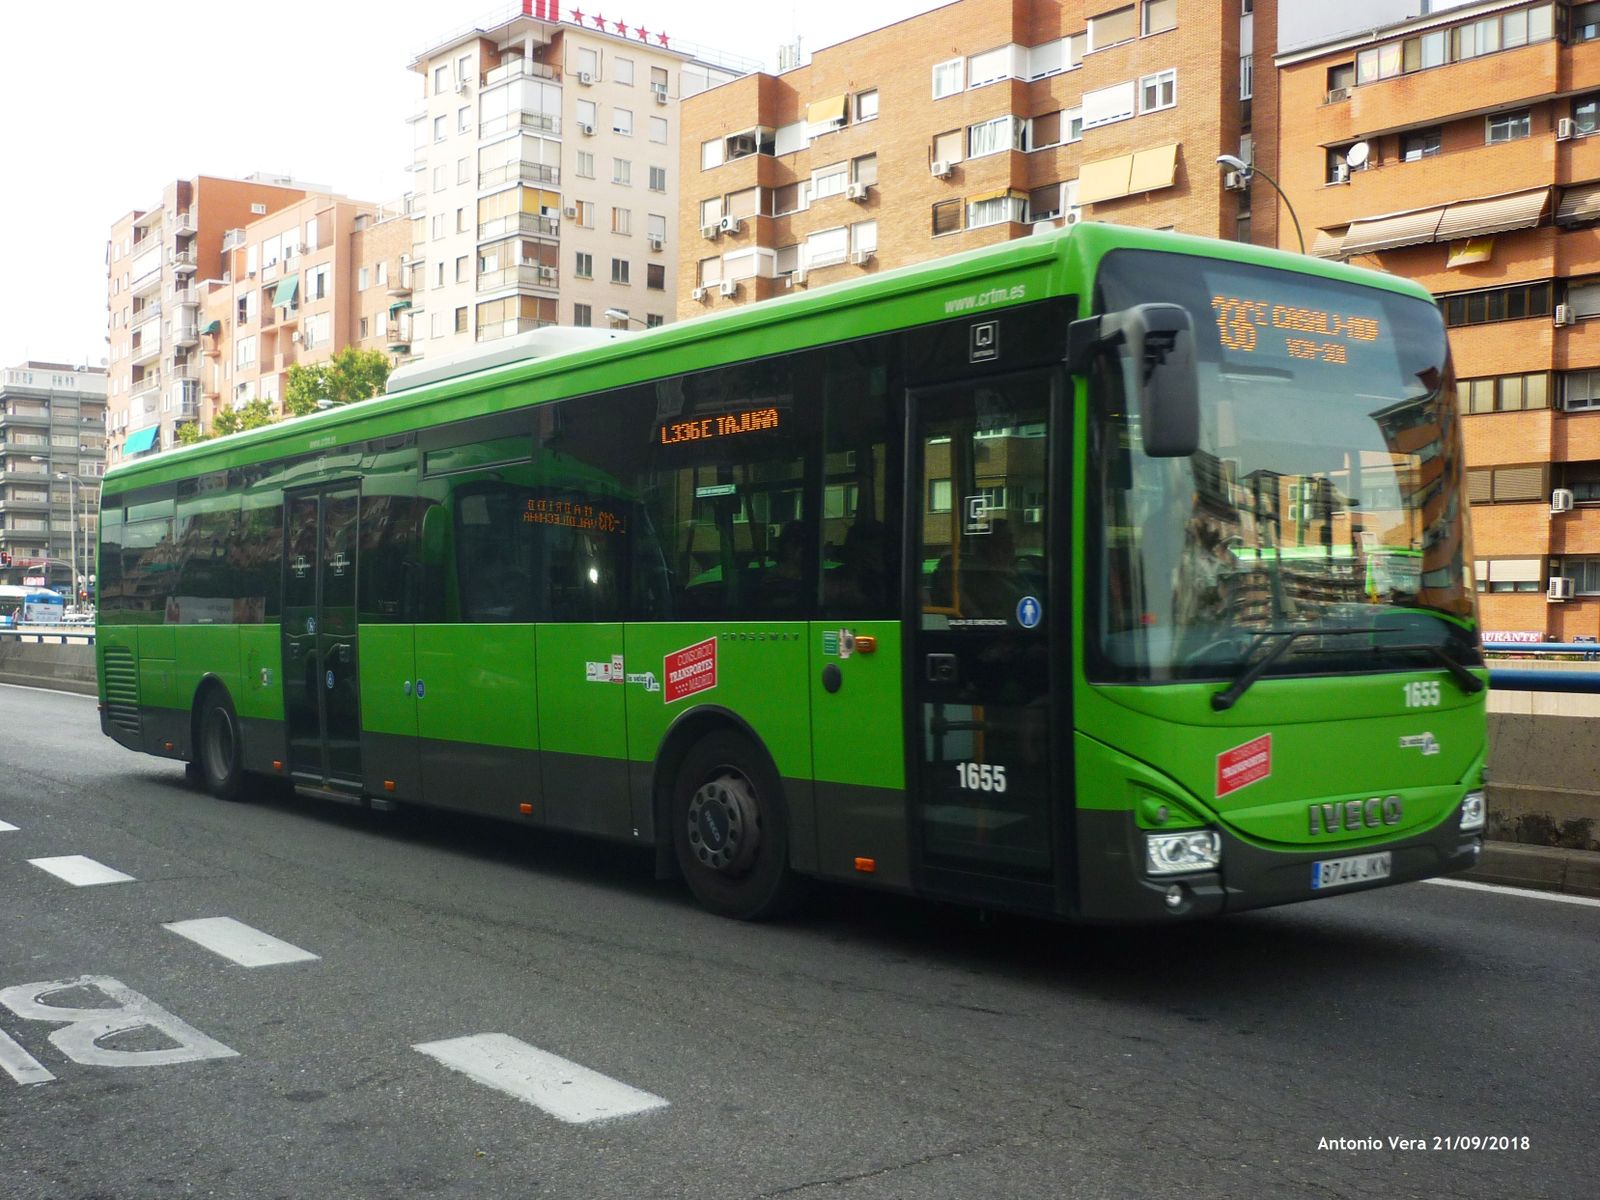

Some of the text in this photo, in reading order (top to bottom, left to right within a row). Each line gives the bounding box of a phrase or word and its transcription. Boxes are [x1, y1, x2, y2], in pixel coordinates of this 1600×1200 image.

[944, 284, 1025, 314] www.crtm.es
[669, 657, 713, 683] TRANSPORTES
[1403, 681, 1440, 707] 1655
[955, 762, 1007, 793] 1655
[1309, 795, 1403, 836] IVECO
